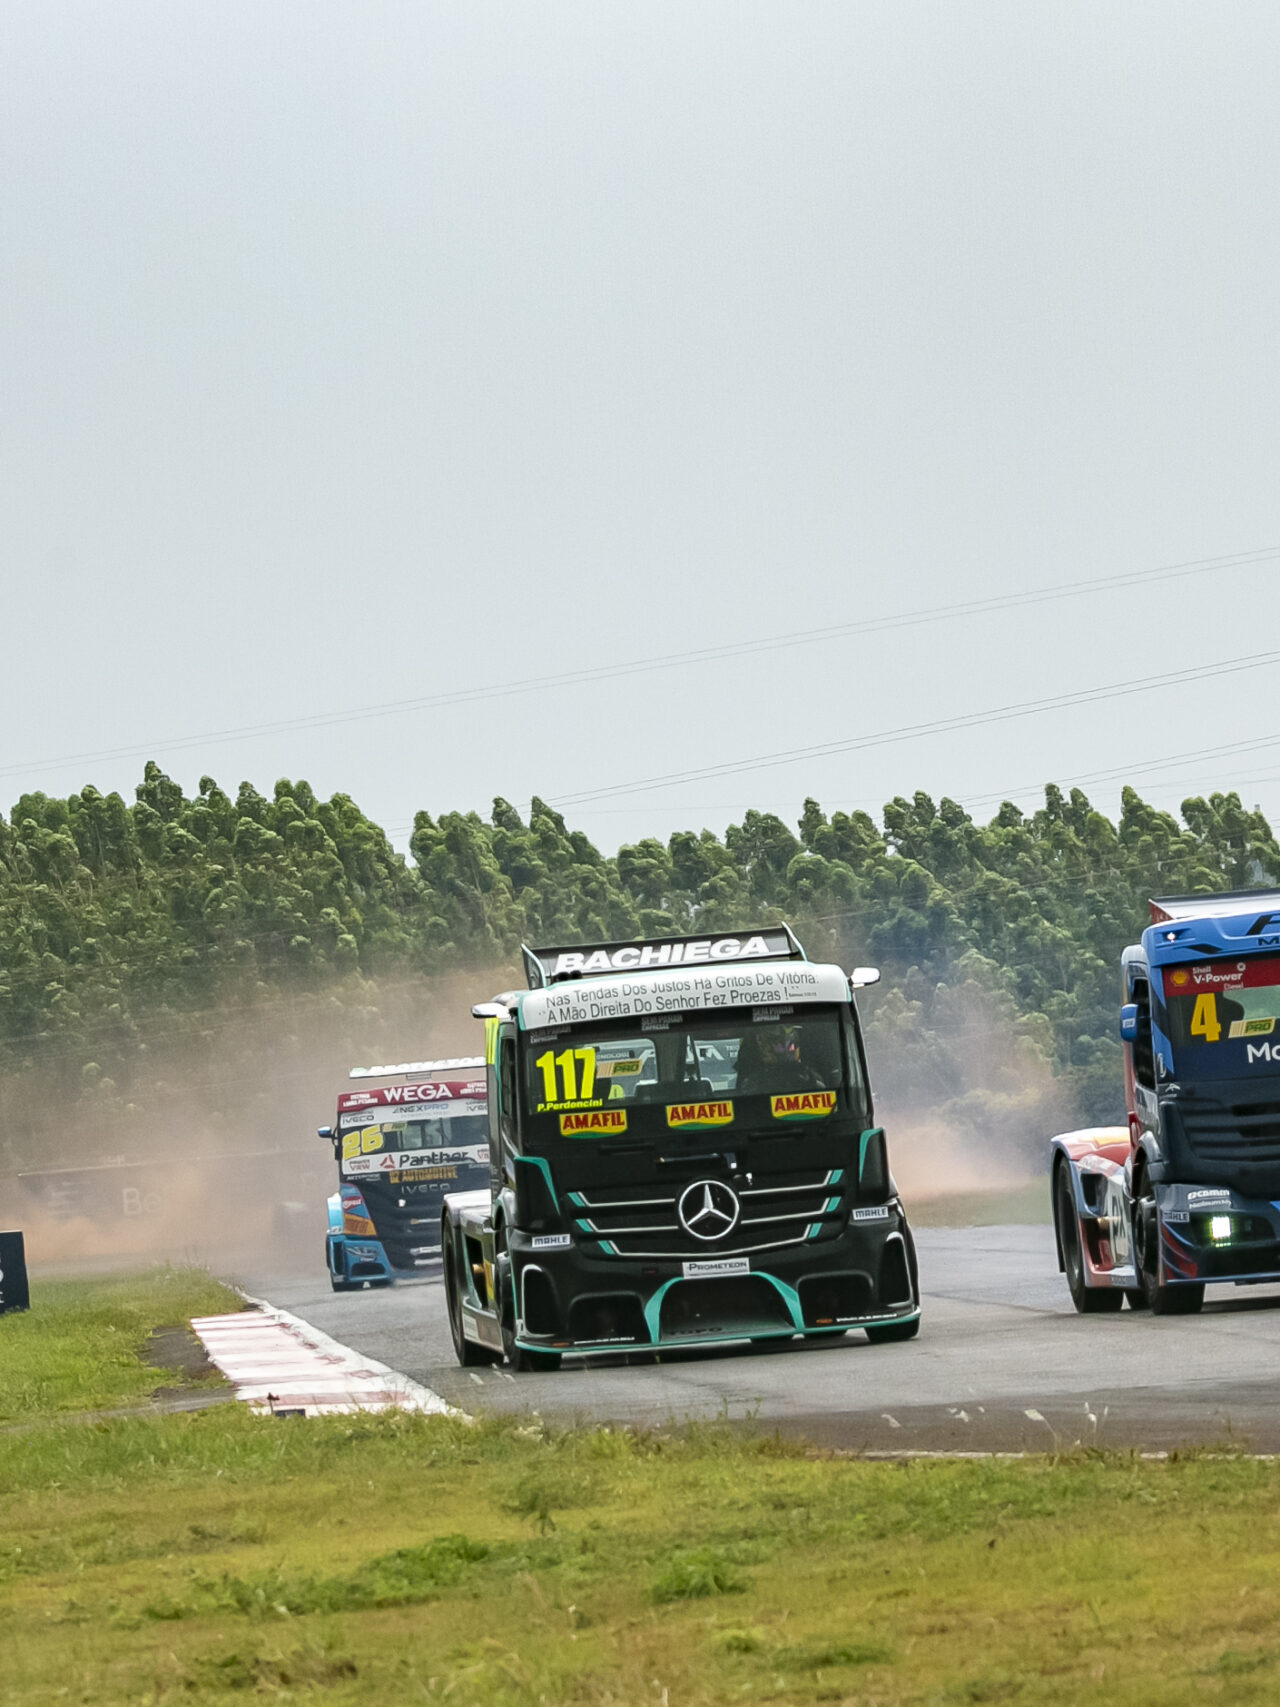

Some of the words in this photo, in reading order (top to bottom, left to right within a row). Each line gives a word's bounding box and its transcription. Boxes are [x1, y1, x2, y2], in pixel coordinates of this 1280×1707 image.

[553, 936, 770, 975] BACHIEGA
[1193, 973, 1243, 984] V-Power
[546, 993, 571, 1009] Nas
[574, 987, 619, 1004] Tendas
[622, 983, 647, 997] Dos
[651, 981, 691, 994] Justos
[756, 972, 774, 986] De
[560, 1006, 587, 1022] Mão
[590, 1000, 631, 1018] Direita
[635, 998, 652, 1013] Do
[656, 994, 700, 1011] Senhor
[704, 992, 727, 1006] Fez
[730, 988, 781, 1004] Proezas
[1190, 993, 1221, 1042] 4
[1245, 1022, 1272, 1034] PRO
[536, 1047, 595, 1102] 117
[612, 1063, 640, 1075] PRO
[384, 1084, 453, 1103] WEGA
[537, 1098, 603, 1112] P.Perdoncini
[670, 1103, 731, 1121] AMAFIL
[774, 1093, 834, 1113] AMAFIL
[342, 1113, 374, 1125] IVECO
[562, 1111, 625, 1130] AMAFIL
[342, 1124, 384, 1160] 26
[399, 1151, 469, 1168] Panther
[401, 1183, 450, 1194] IVECO
[122, 1187, 163, 1216] Be
[855, 1207, 888, 1219] MAHLE
[534, 1234, 569, 1246] MAHLE
